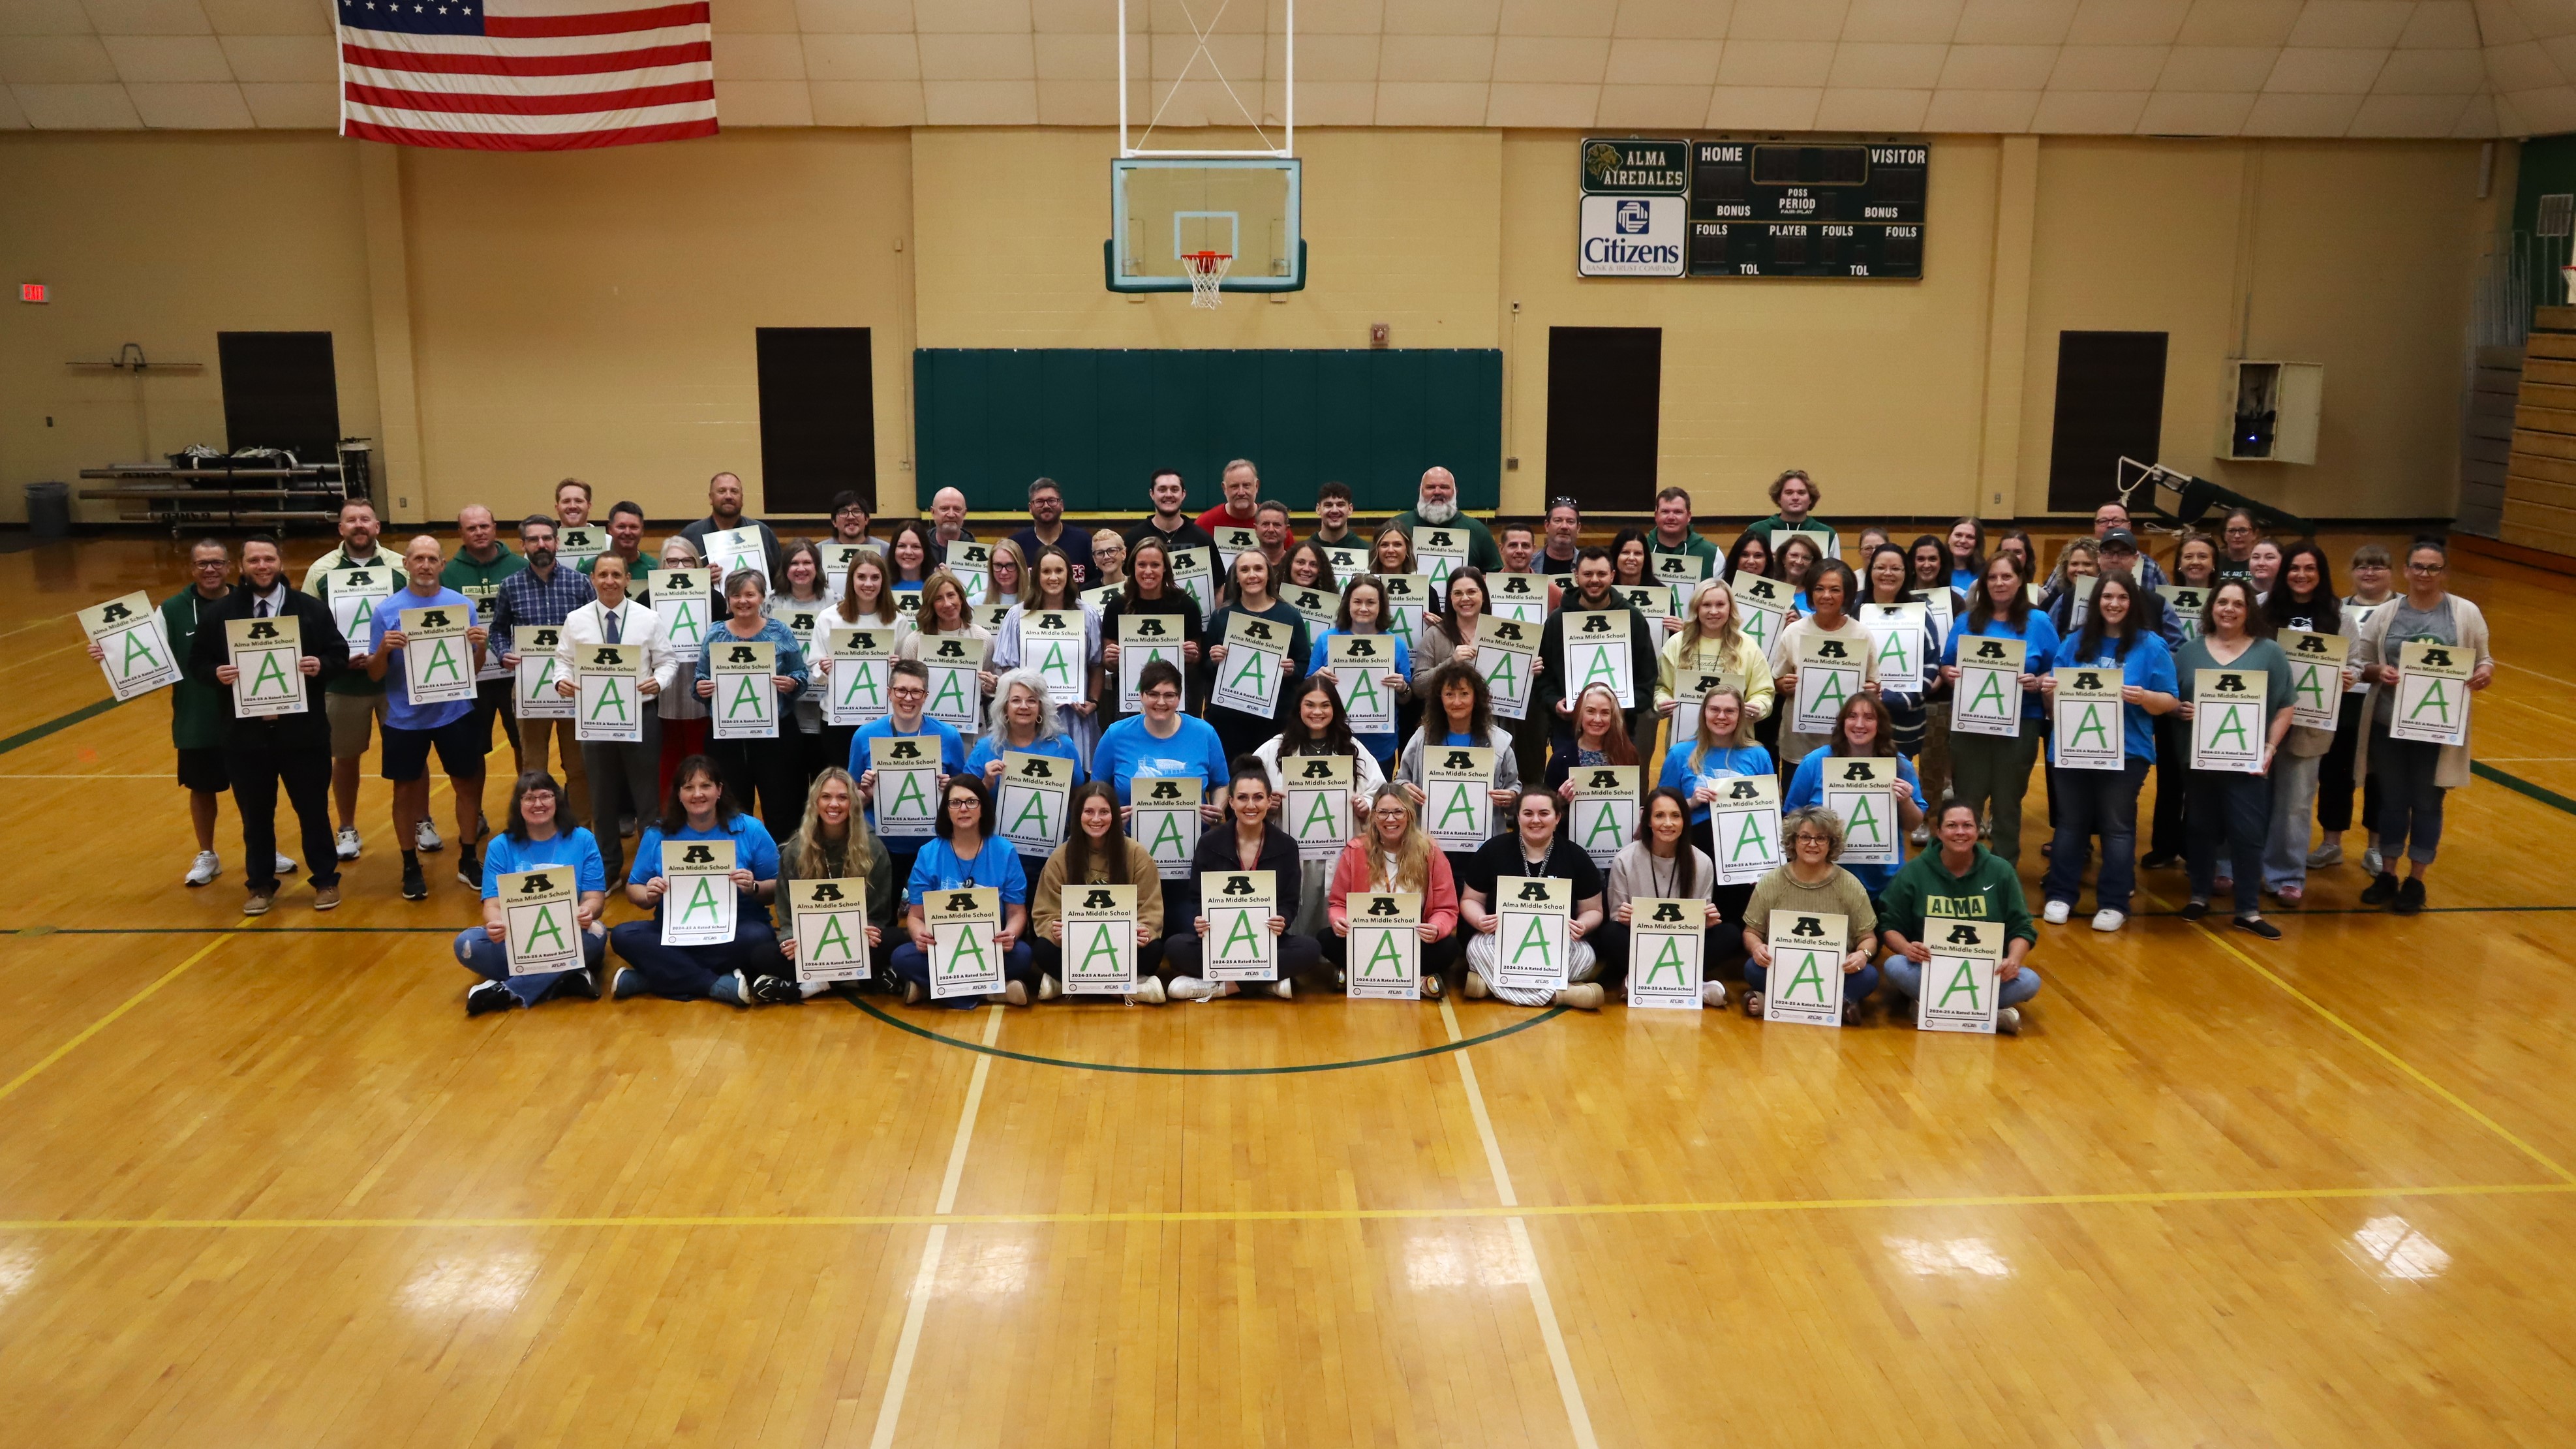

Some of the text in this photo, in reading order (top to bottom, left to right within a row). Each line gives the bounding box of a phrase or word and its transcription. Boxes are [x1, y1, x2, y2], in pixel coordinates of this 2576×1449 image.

[1627, 151, 1666, 166] ALMA
[1702, 147, 1743, 162] HOME
[1871, 149, 1925, 164] VISITOR
[1603, 171, 1683, 185] AIREDALES
[1788, 189, 1807, 197] POSS
[1717, 206, 1751, 216] BONUS
[1779, 198, 1816, 209] PERIOD
[1865, 207, 1898, 218] BONUS
[1696, 224, 1728, 235] FOULS
[1770, 225, 1854, 236] PLAYER FOULS
[1886, 226, 1917, 237] FOULS
[1585, 237, 1679, 264] Citizens
[1740, 264, 1760, 275] TOL
[1850, 265, 1869, 275] TOL
[24, 284, 44, 300] EXIT
[1245, 637, 1264, 646] Middle
[1265, 642, 1283, 650] School
[253, 652, 288, 694] A
[845, 661, 879, 706] A
[1231, 651, 1266, 697] A
[592, 678, 626, 721] A
[2412, 680, 2447, 720] A
[2072, 704, 2107, 748] A
[891, 772, 928, 816] A
[549, 889, 570, 898] School
[681, 876, 719, 925] A
[1932, 898, 1982, 915] ALMA
[526, 906, 564, 953] A
[814, 915, 851, 960] A
[1221, 909, 1259, 958] A
[1512, 915, 1551, 966] A
[947, 924, 986, 973] A
[1081, 923, 1119, 971] A
[1365, 930, 1402, 977] A
[1646, 936, 1685, 986] A
[1785, 951, 1824, 1002] A
[1939, 960, 1978, 1008] A
